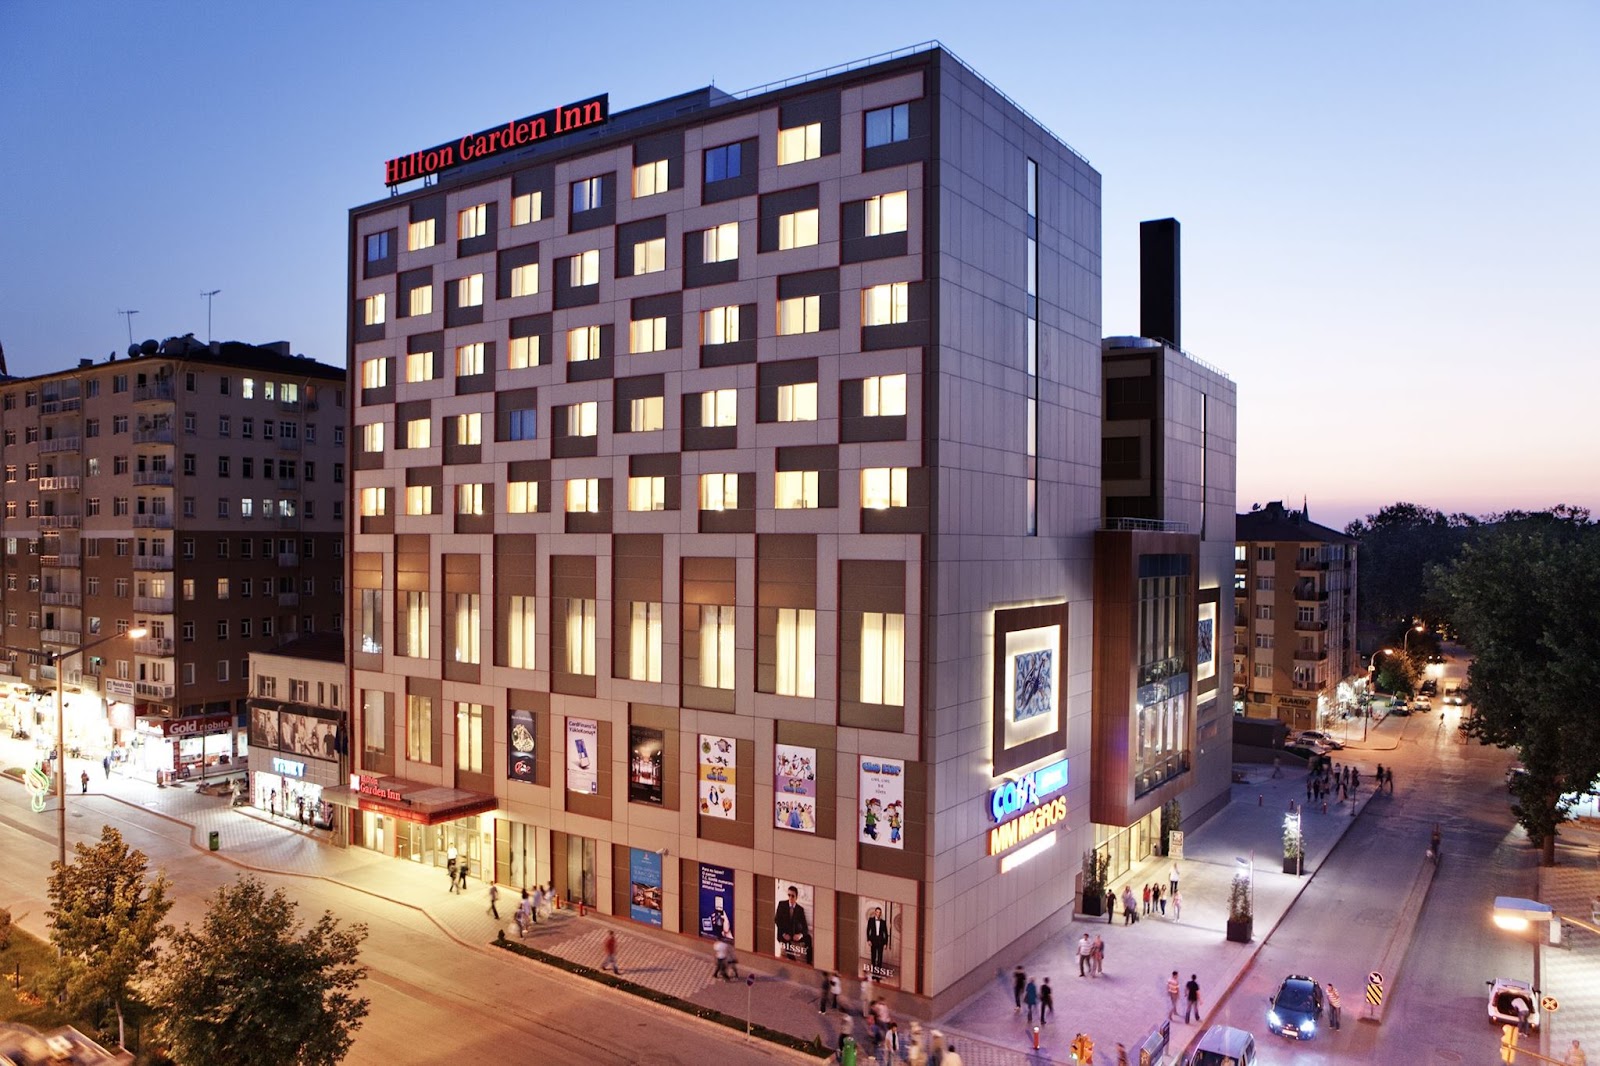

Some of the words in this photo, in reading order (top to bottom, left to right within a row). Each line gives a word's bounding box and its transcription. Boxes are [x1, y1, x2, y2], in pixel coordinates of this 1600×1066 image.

[385, 147, 454, 184] Hilton
[459, 120, 547, 161] Garden
[554, 100, 603, 134] Inn
[169, 720, 197, 734] Gold
[360, 783, 387, 798] Garden
[387, 789, 401, 801] Inn
[780, 942, 808, 955] BISSE
[863, 963, 894, 977] BISSE
